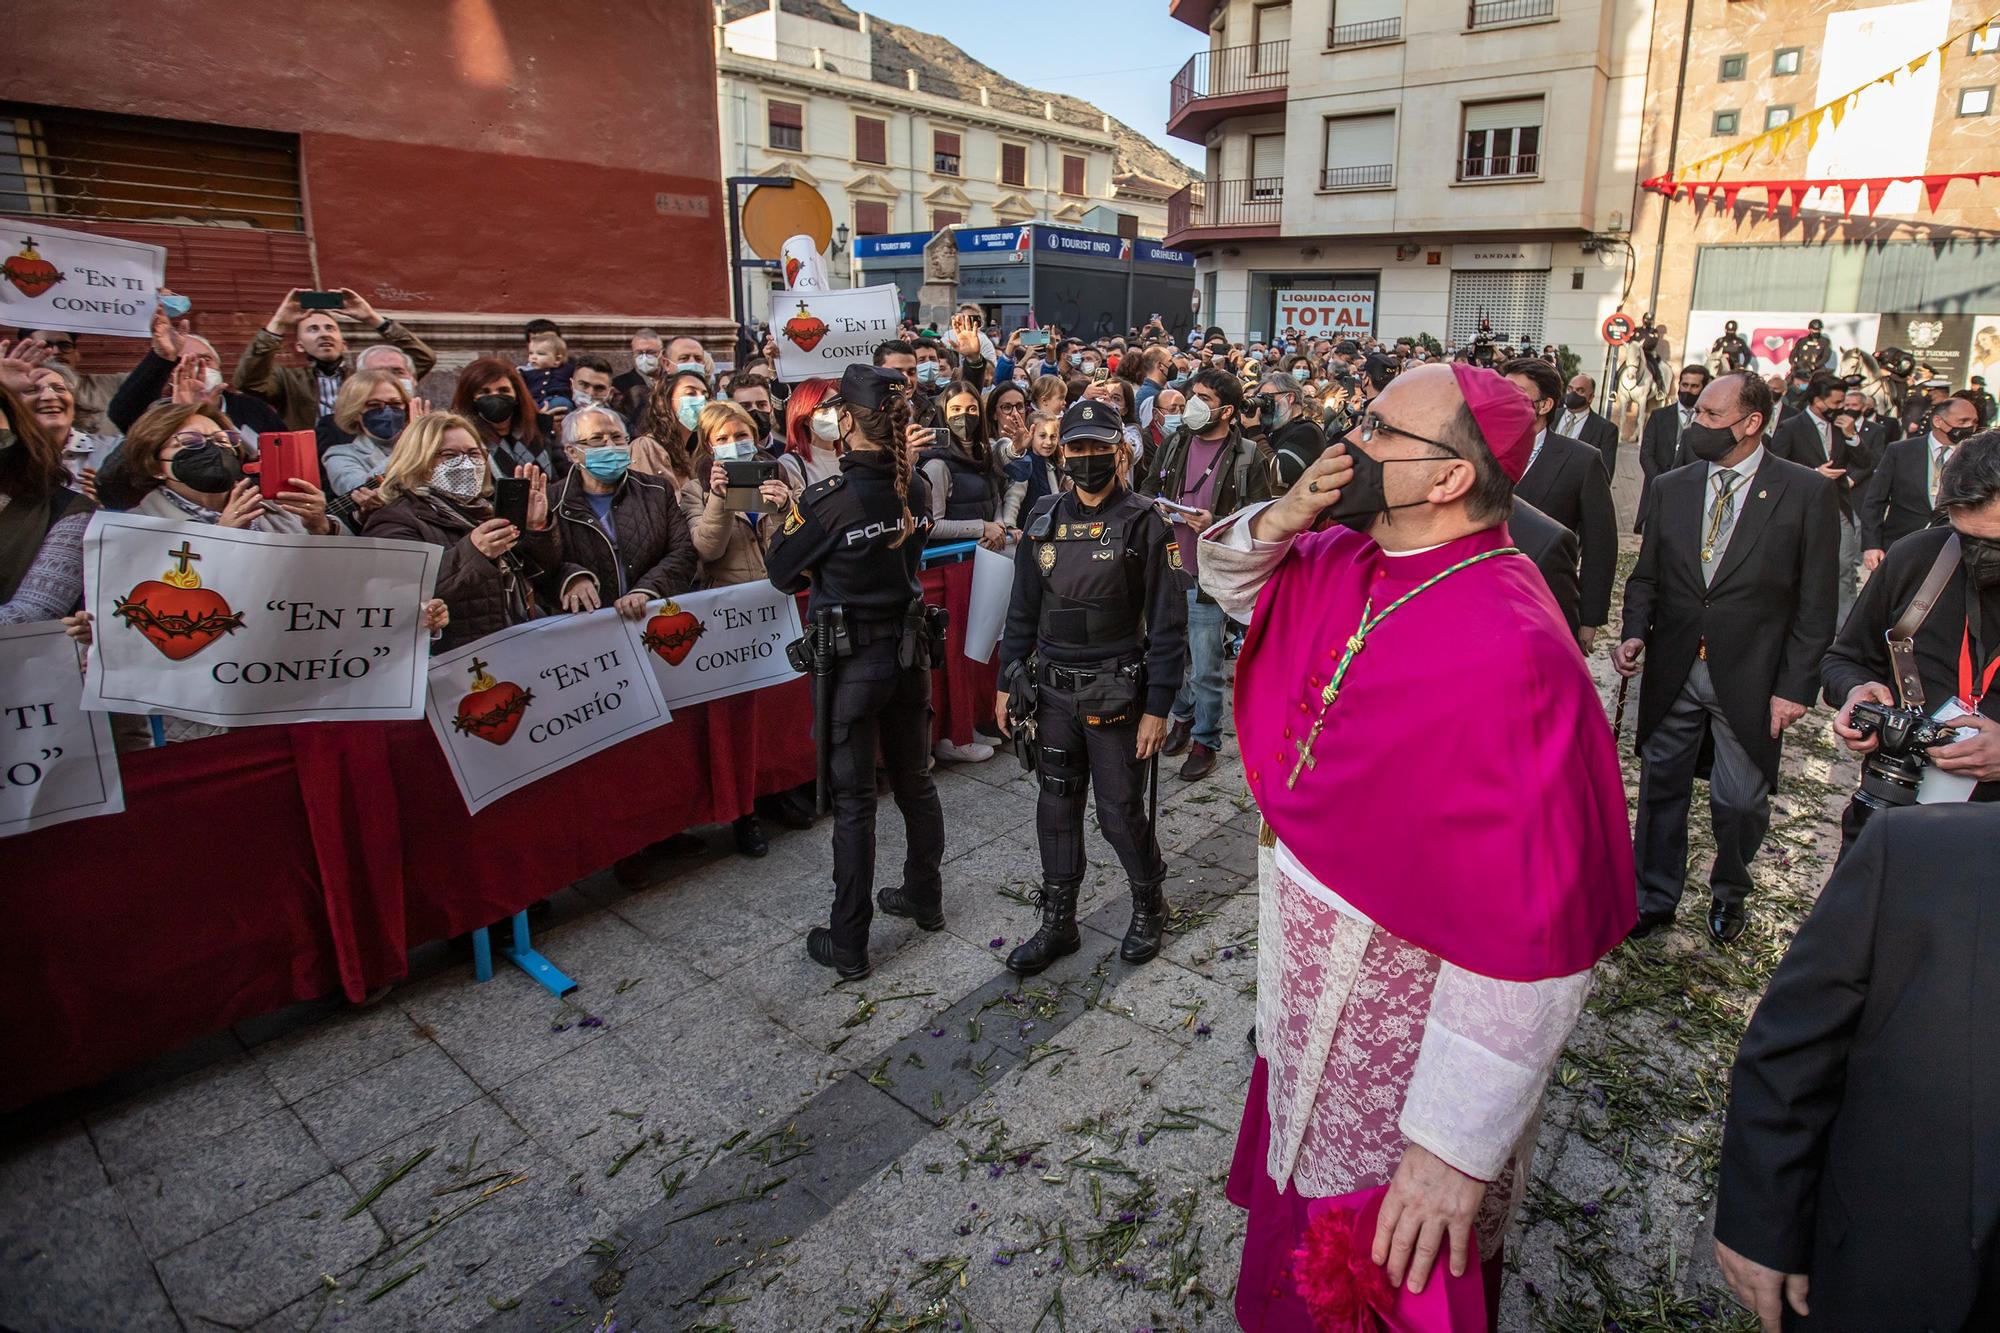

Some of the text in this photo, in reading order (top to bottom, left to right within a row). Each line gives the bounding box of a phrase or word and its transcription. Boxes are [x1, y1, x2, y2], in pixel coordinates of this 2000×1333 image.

[880, 241, 911, 251] TOURIST INFO
[980, 232, 1014, 242] TOURIST INFO
[1060, 237, 1111, 252] TOURIST INFO
[1150, 248, 1183, 262] ORIHUELA
[74, 266, 144, 291] “EN TI
[52, 297, 145, 316] CONFÍO”
[1281, 292, 1371, 303] LIQUIDACIÓN
[835, 317, 887, 332] “EN TI
[1281, 306, 1370, 327] TOTAL
[266, 600, 395, 632] “EN TI
[713, 605, 778, 631] “EN TI
[695, 633, 781, 672] CONFÍO”
[212, 646, 391, 684] CONFÍO”
[540, 650, 621, 690] “EN TI
[5, 702, 59, 731] TI
[529, 679, 629, 743] CONFÍO”
